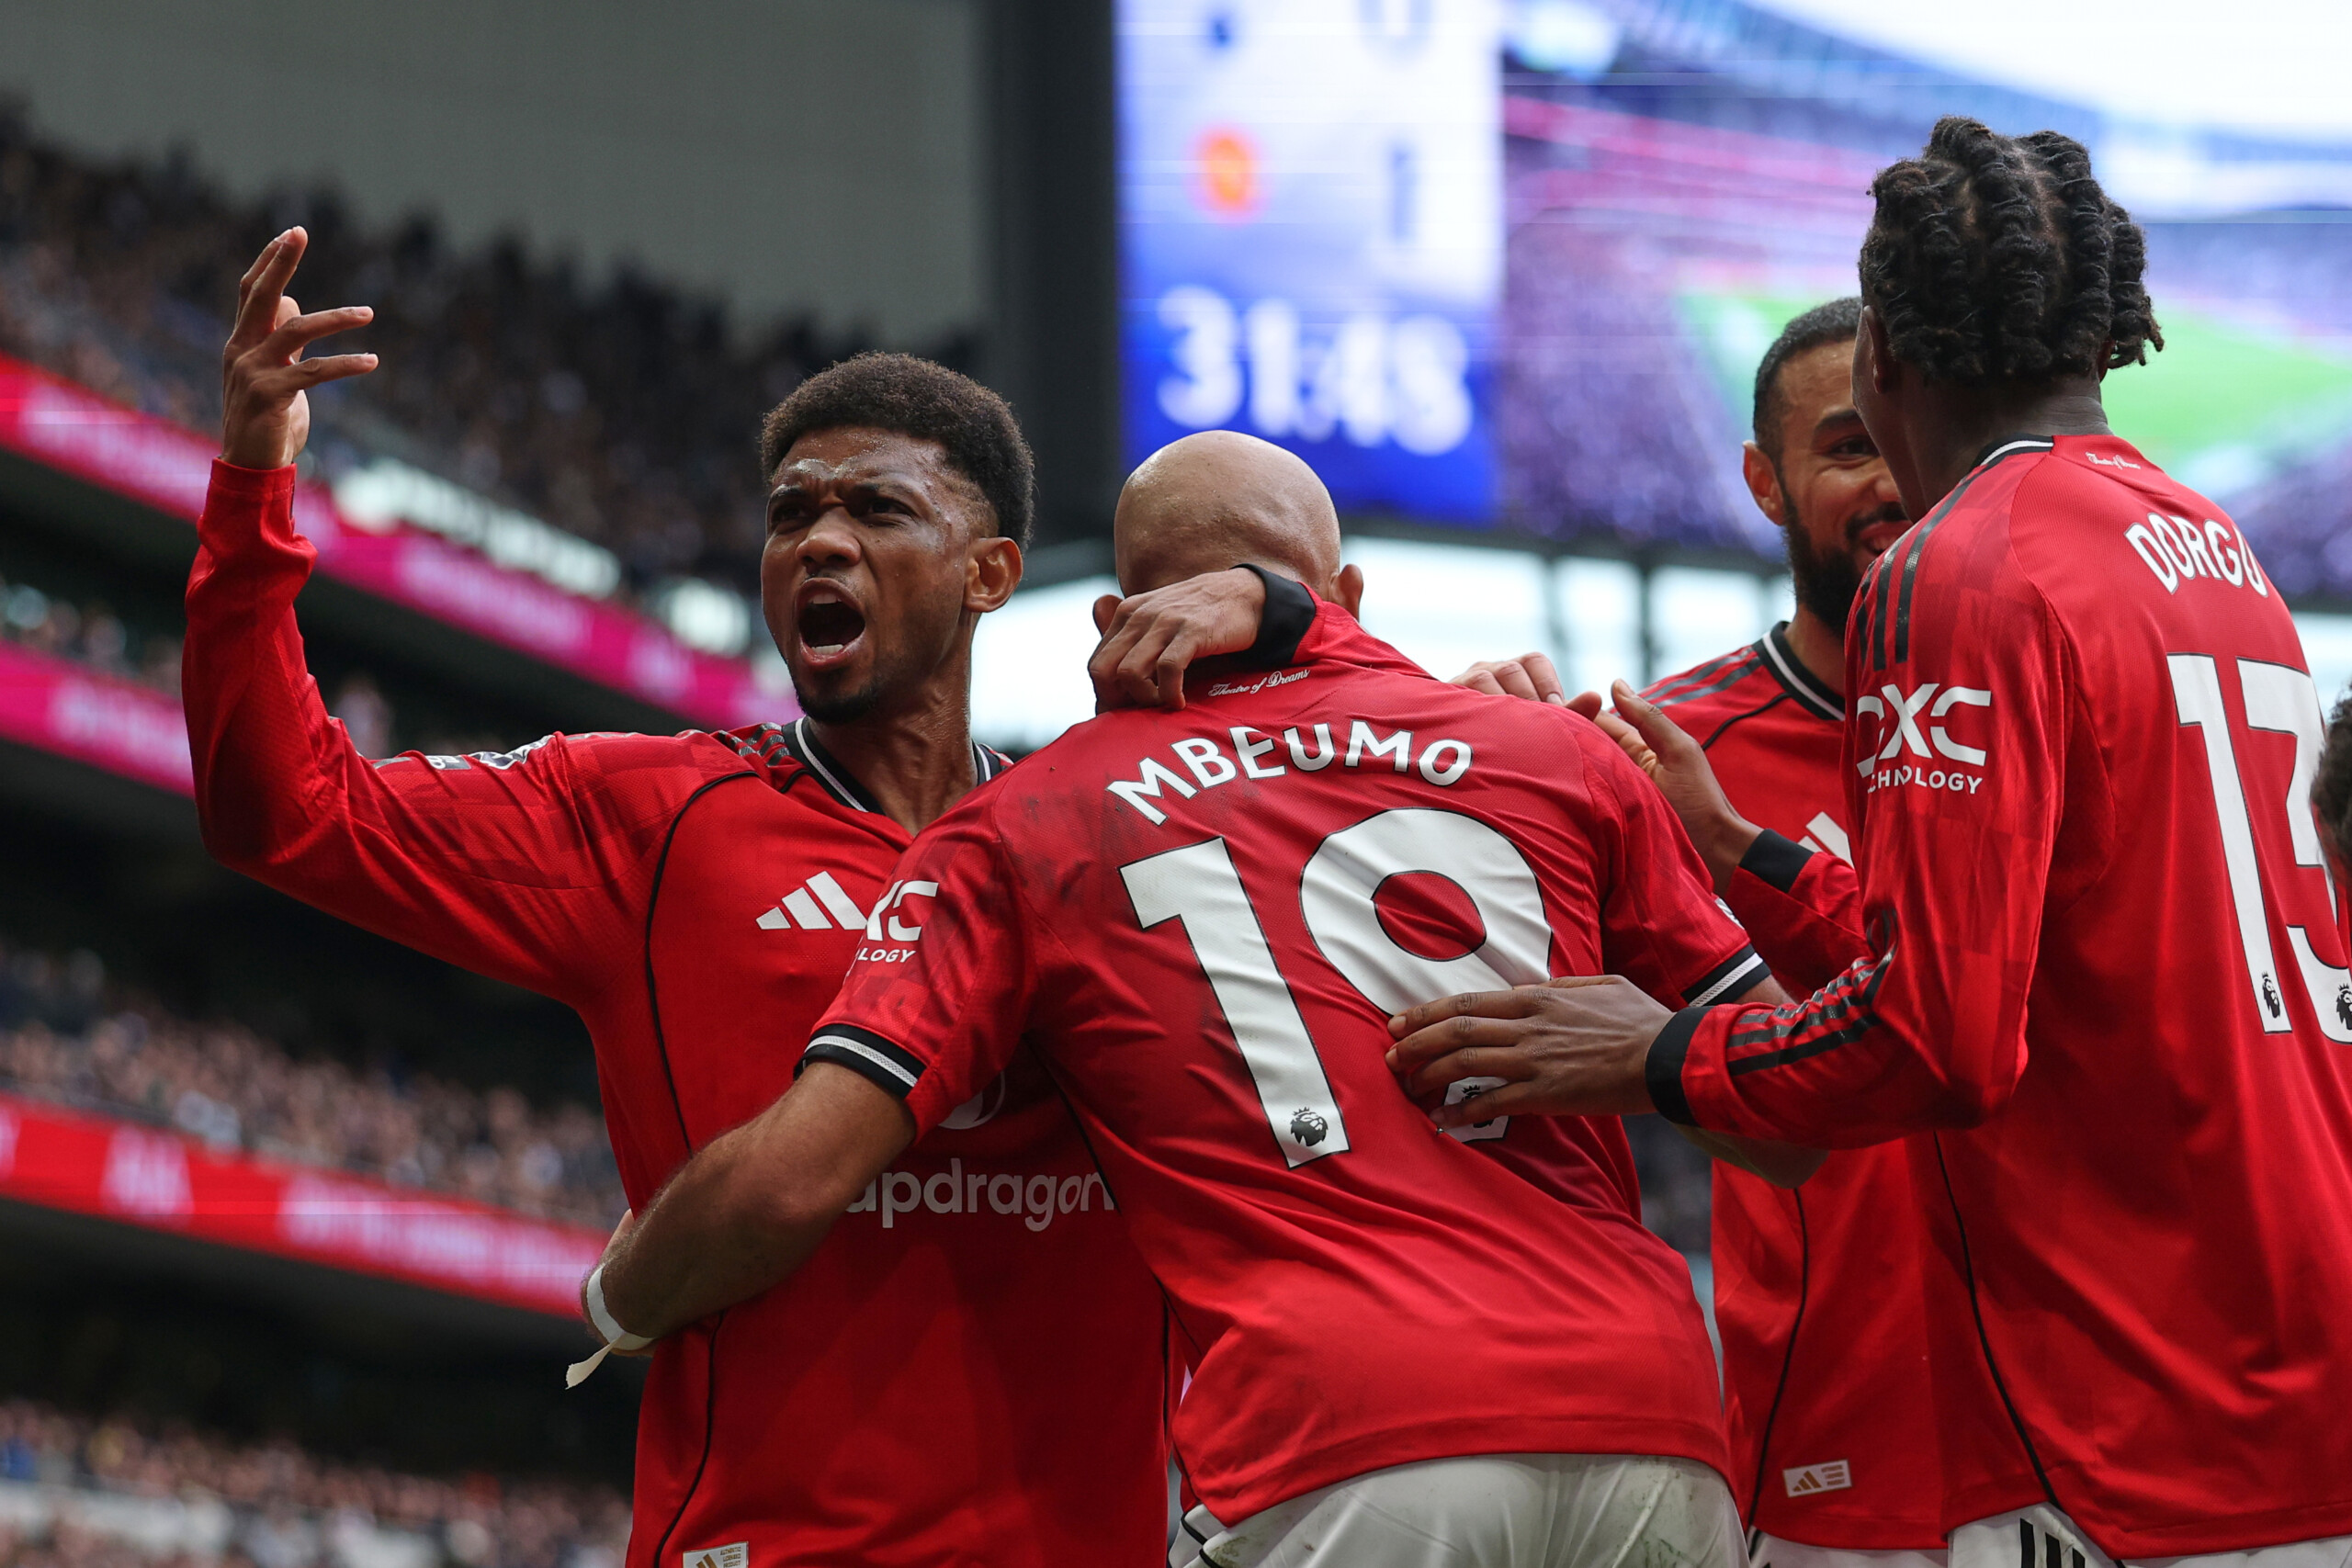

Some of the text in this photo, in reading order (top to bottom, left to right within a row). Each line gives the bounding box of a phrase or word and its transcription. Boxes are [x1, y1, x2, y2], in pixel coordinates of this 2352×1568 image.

[2124, 513, 2268, 597] DORGU
[1208, 669, 1310, 696] Theatre of Dreams
[1107, 720, 1473, 826] MBEUMO
[2166, 652, 2352, 1044] 13
[1119, 807, 1552, 1169] 19
